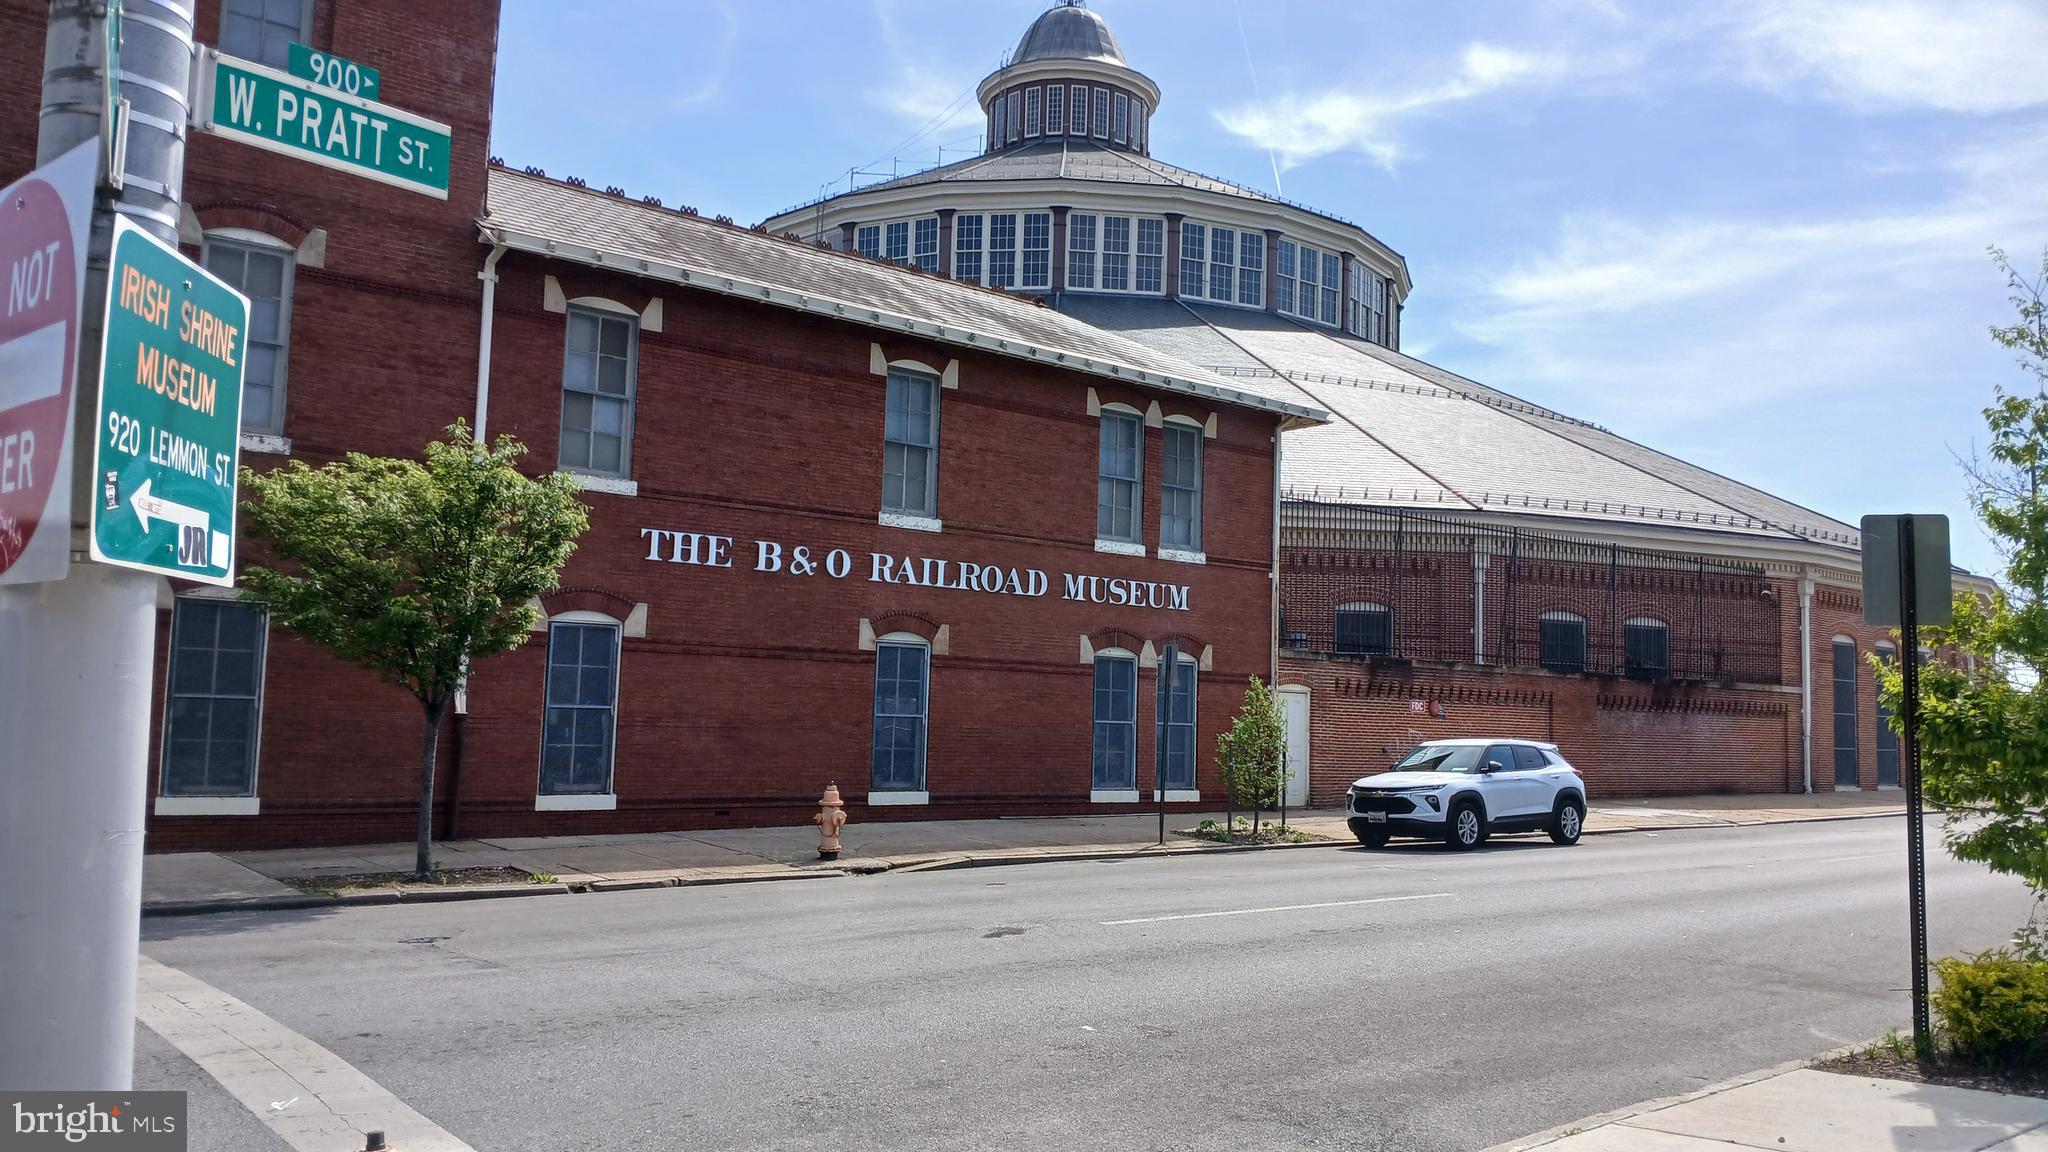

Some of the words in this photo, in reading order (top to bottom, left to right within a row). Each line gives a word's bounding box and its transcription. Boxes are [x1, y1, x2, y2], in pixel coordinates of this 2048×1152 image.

[309, 53, 360, 96] 900
[229, 74, 262, 131] W.
[276, 95, 388, 166] PRATT
[398, 137, 433, 172] ST.
[8, 240, 60, 317] NOT
[120, 264, 171, 330] IRISH
[179, 300, 237, 367] SHRINE
[136, 342, 216, 416] MUSEUM
[0, 430, 35, 493] ER
[109, 411, 140, 456] 920
[149, 426, 207, 480] LEMMON
[214, 453, 231, 487] ST.
[179, 525, 206, 565] JR
[641, 528, 733, 568] THE
[753, 540, 851, 578] B&O
[867, 552, 1048, 597] RAILROAD
[1061, 573, 1190, 611] MUSEUM
[1412, 702, 1424, 710] FDC
